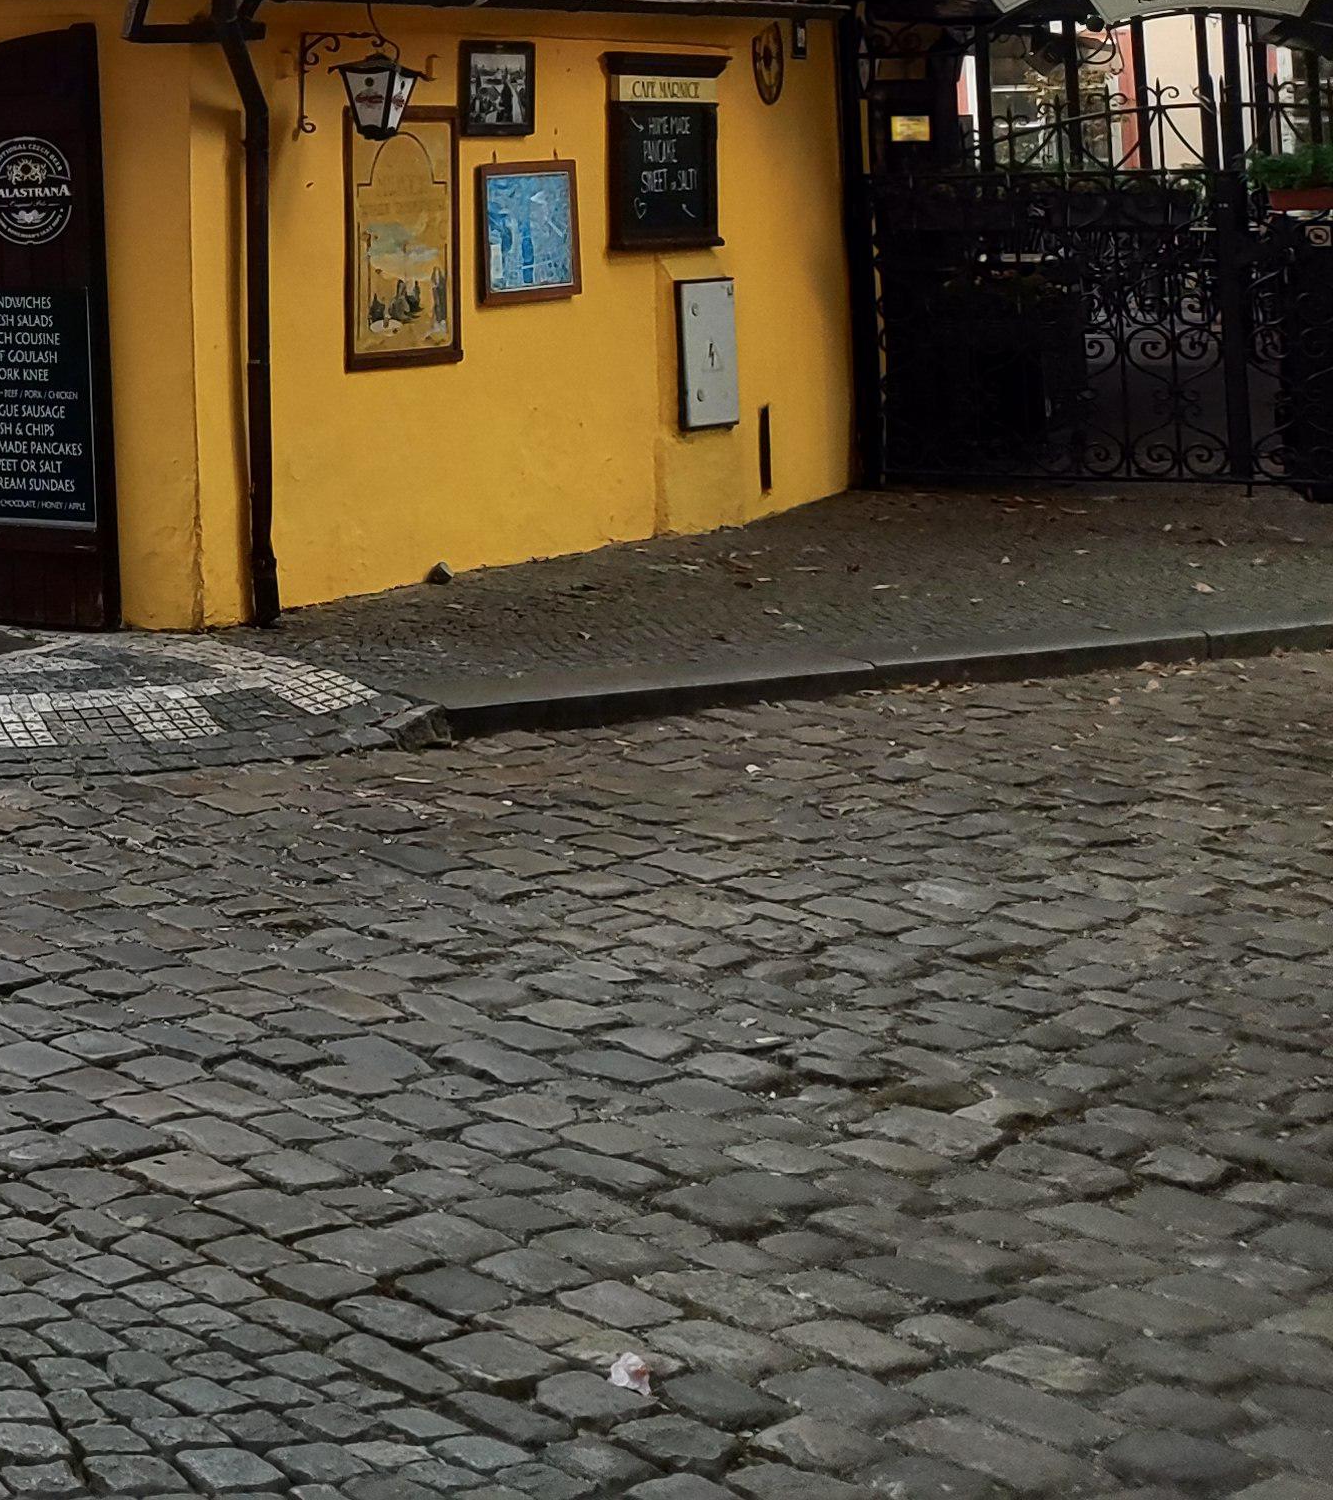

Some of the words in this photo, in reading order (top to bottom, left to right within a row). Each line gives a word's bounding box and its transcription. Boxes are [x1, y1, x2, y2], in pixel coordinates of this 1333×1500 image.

[17, 314, 54, 328] SALADS
[15, 332, 61, 346] COUSINE
[7, 349, 58, 364] GOULASH
[23, 368, 50, 382] KNEE
[47, 390, 79, 400] CHICKEN
[21, 404, 66, 419] SAUSAGE
[15, 422, 23, 436] &
[25, 423, 54, 437] CHIPS
[30, 441, 83, 456] PANCAKES
[20, 459, 37, 473] OR
[39, 460, 63, 474] SALT
[29, 478, 75, 493] SUNDAES
[68, 502, 86, 511] APPLE
